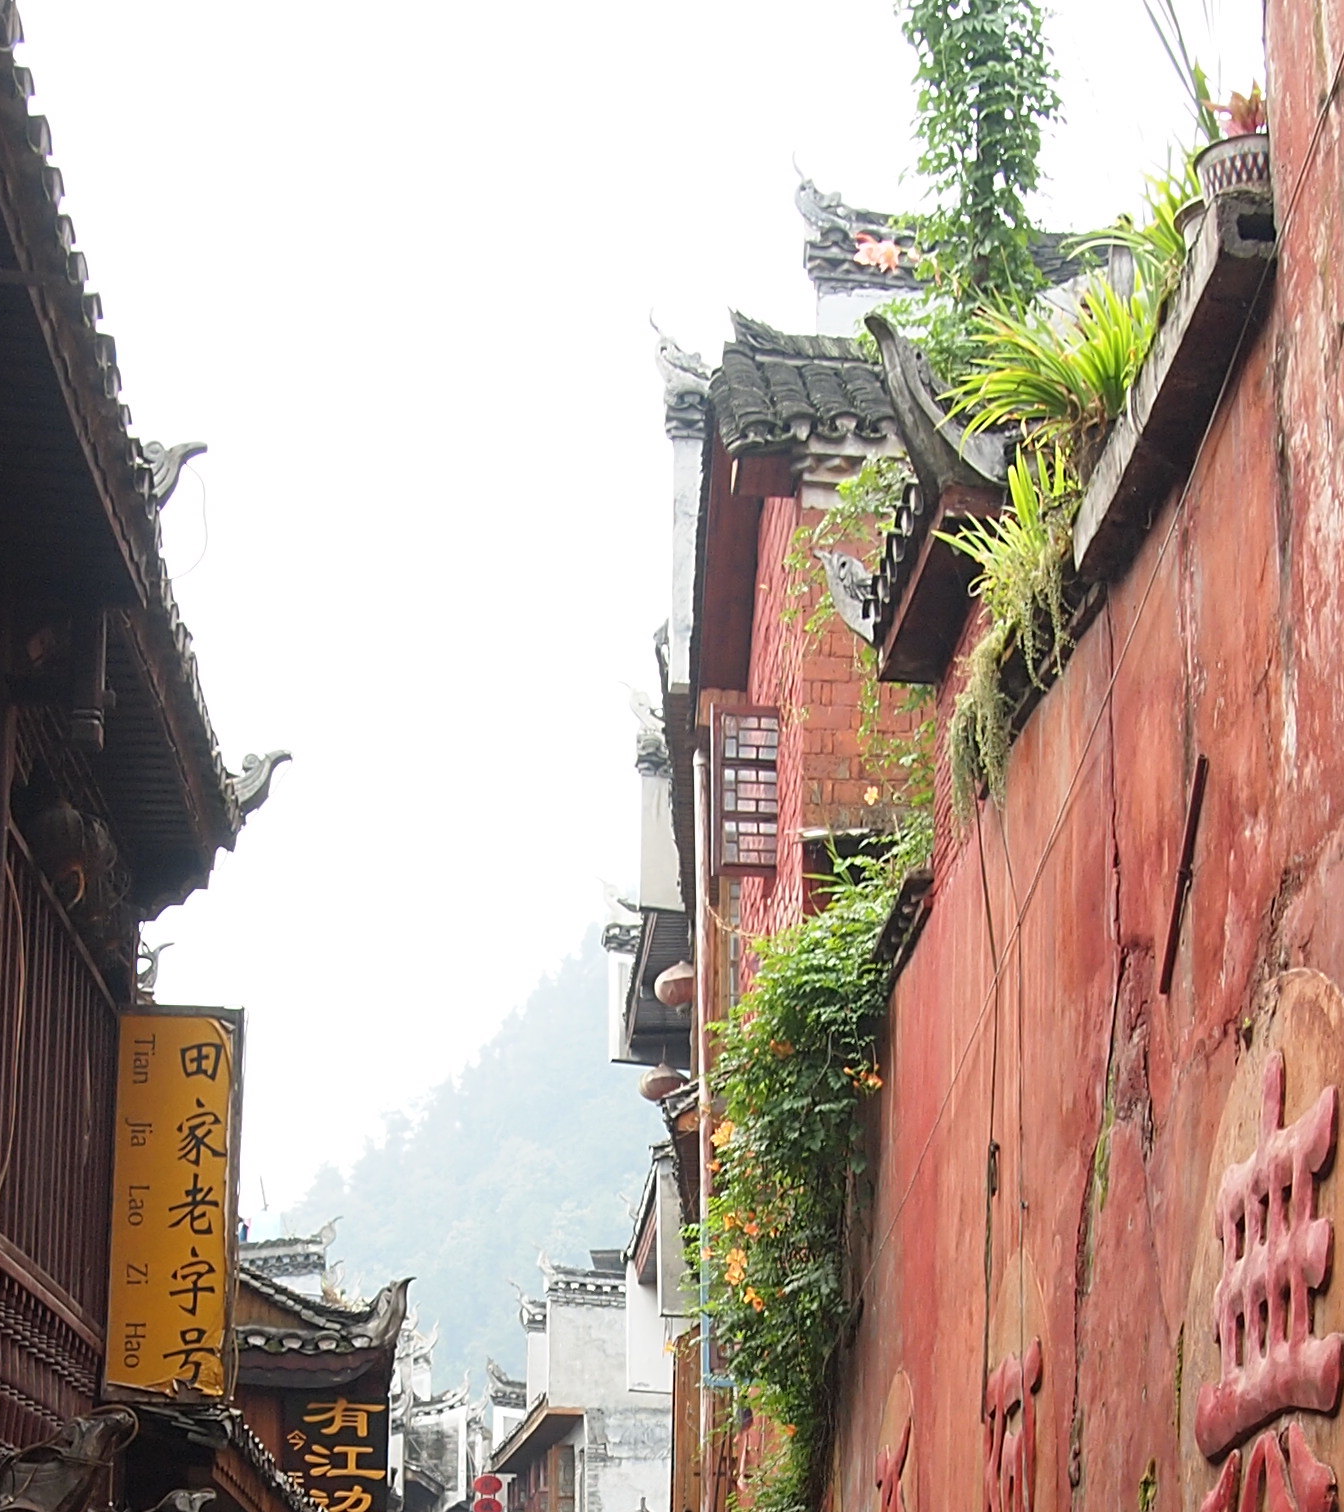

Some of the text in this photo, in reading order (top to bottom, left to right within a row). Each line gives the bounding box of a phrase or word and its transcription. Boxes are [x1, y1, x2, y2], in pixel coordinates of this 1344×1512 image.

[123, 1033, 157, 1369] Tian Jia Lao Zi Hao
[163, 1041, 227, 1386] 田家老字号
